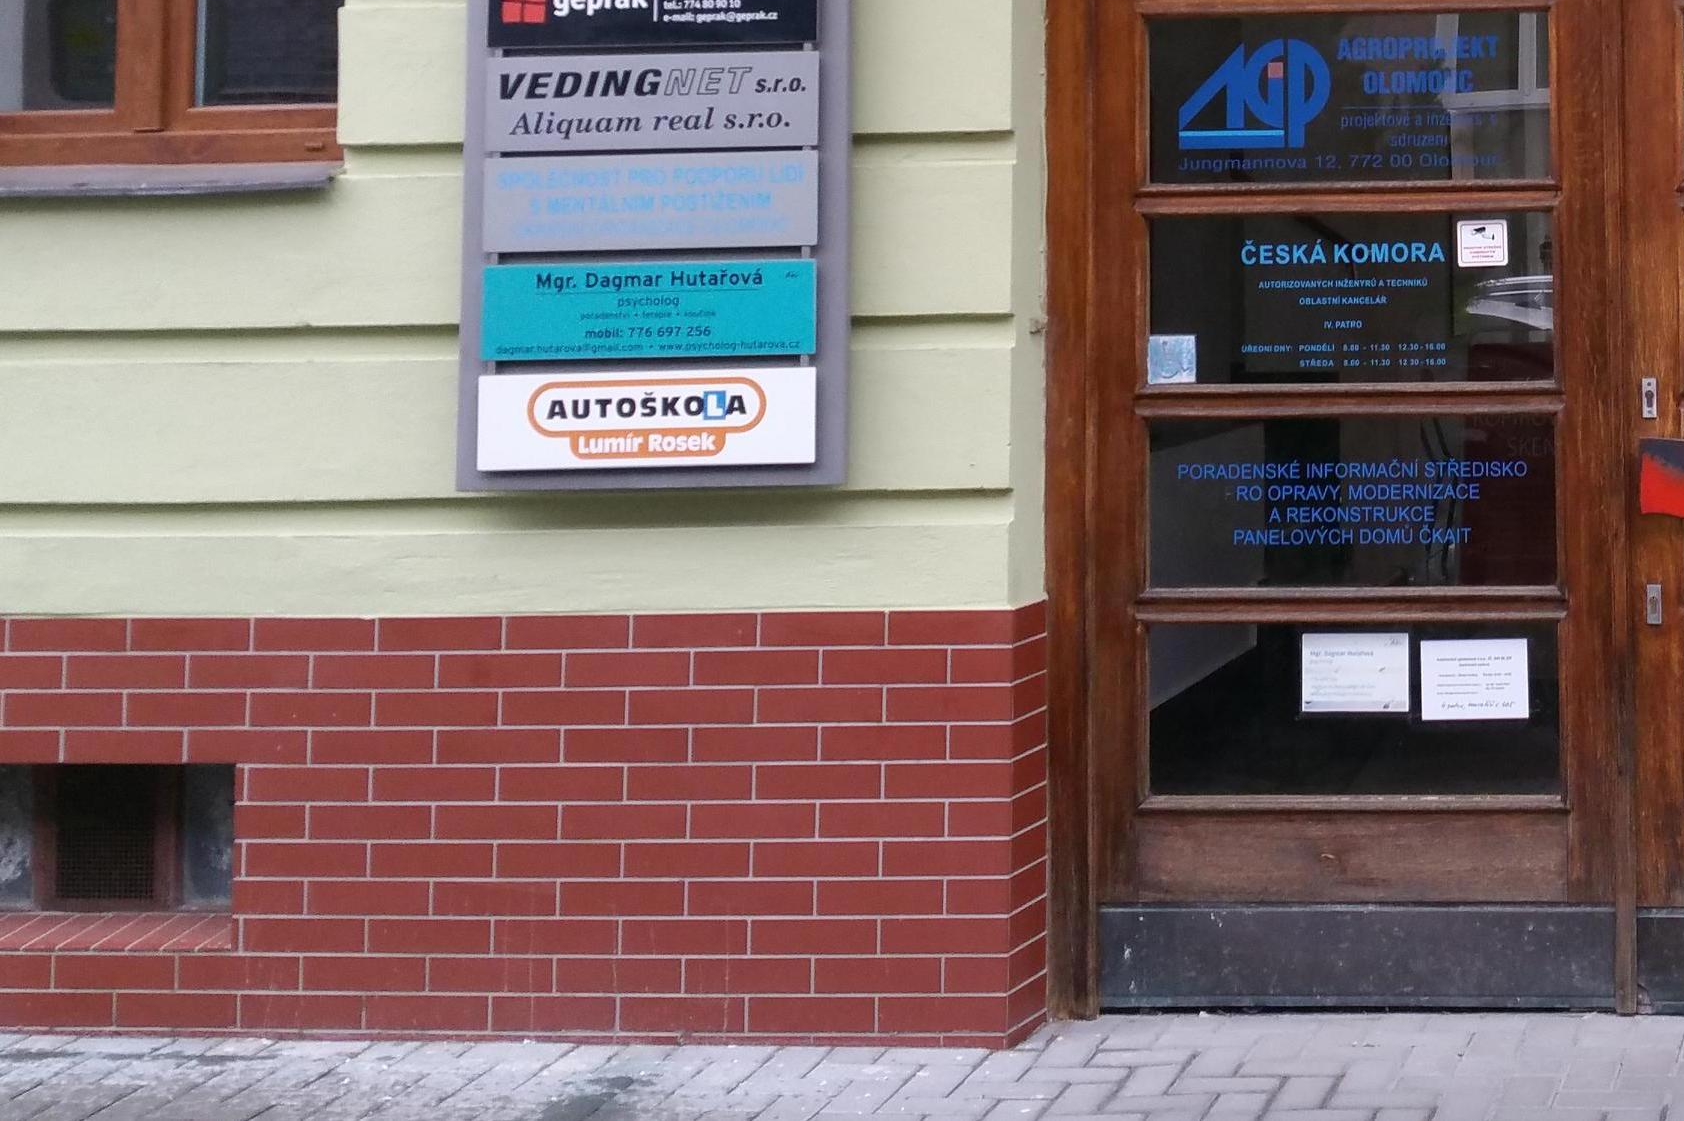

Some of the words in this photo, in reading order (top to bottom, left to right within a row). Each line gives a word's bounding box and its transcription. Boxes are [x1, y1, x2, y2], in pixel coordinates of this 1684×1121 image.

[684, 0, 701, 9] 774
[729, 0, 741, 8] 10
[755, 75, 807, 94] s.r.o.
[509, 111, 642, 140] Aliquam
[653, 106, 715, 132] real
[723, 109, 792, 130] s.r.o.
[1179, 155, 1307, 171] Jungmannova
[1350, 155, 1383, 168] 772
[1241, 239, 1325, 265] ČESKÁ
[1334, 242, 1445, 264] KOMORA
[536, 274, 577, 293] Mgr.
[585, 272, 663, 291] Dagmar
[670, 268, 763, 287] Hutařová
[617, 294, 680, 309] psycholog
[585, 326, 624, 339] mobil:
[627, 327, 653, 338] 776
[656, 326, 681, 337] 697
[686, 325, 712, 337] 256
[546, 390, 747, 420] AUTOŠKOLA
[577, 431, 643, 456] Lumír
[648, 431, 716, 454] Rosek
[1177, 460, 1301, 480] PORADENSKÉ
[1306, 458, 1418, 479] INFORMAČNÍ
[1424, 458, 1528, 478] STŘEDISKO
[1268, 485, 1343, 503] OPRAVY,
[1349, 483, 1480, 501] MODERNIZACE
[1269, 507, 1281, 523] A
[1287, 505, 1435, 524] REKONSTRUKCE
[1233, 524, 1354, 545] PANELOVÝCH
[1359, 526, 1413, 544] DOMŮ
[1419, 525, 1471, 544] ČKAIT
